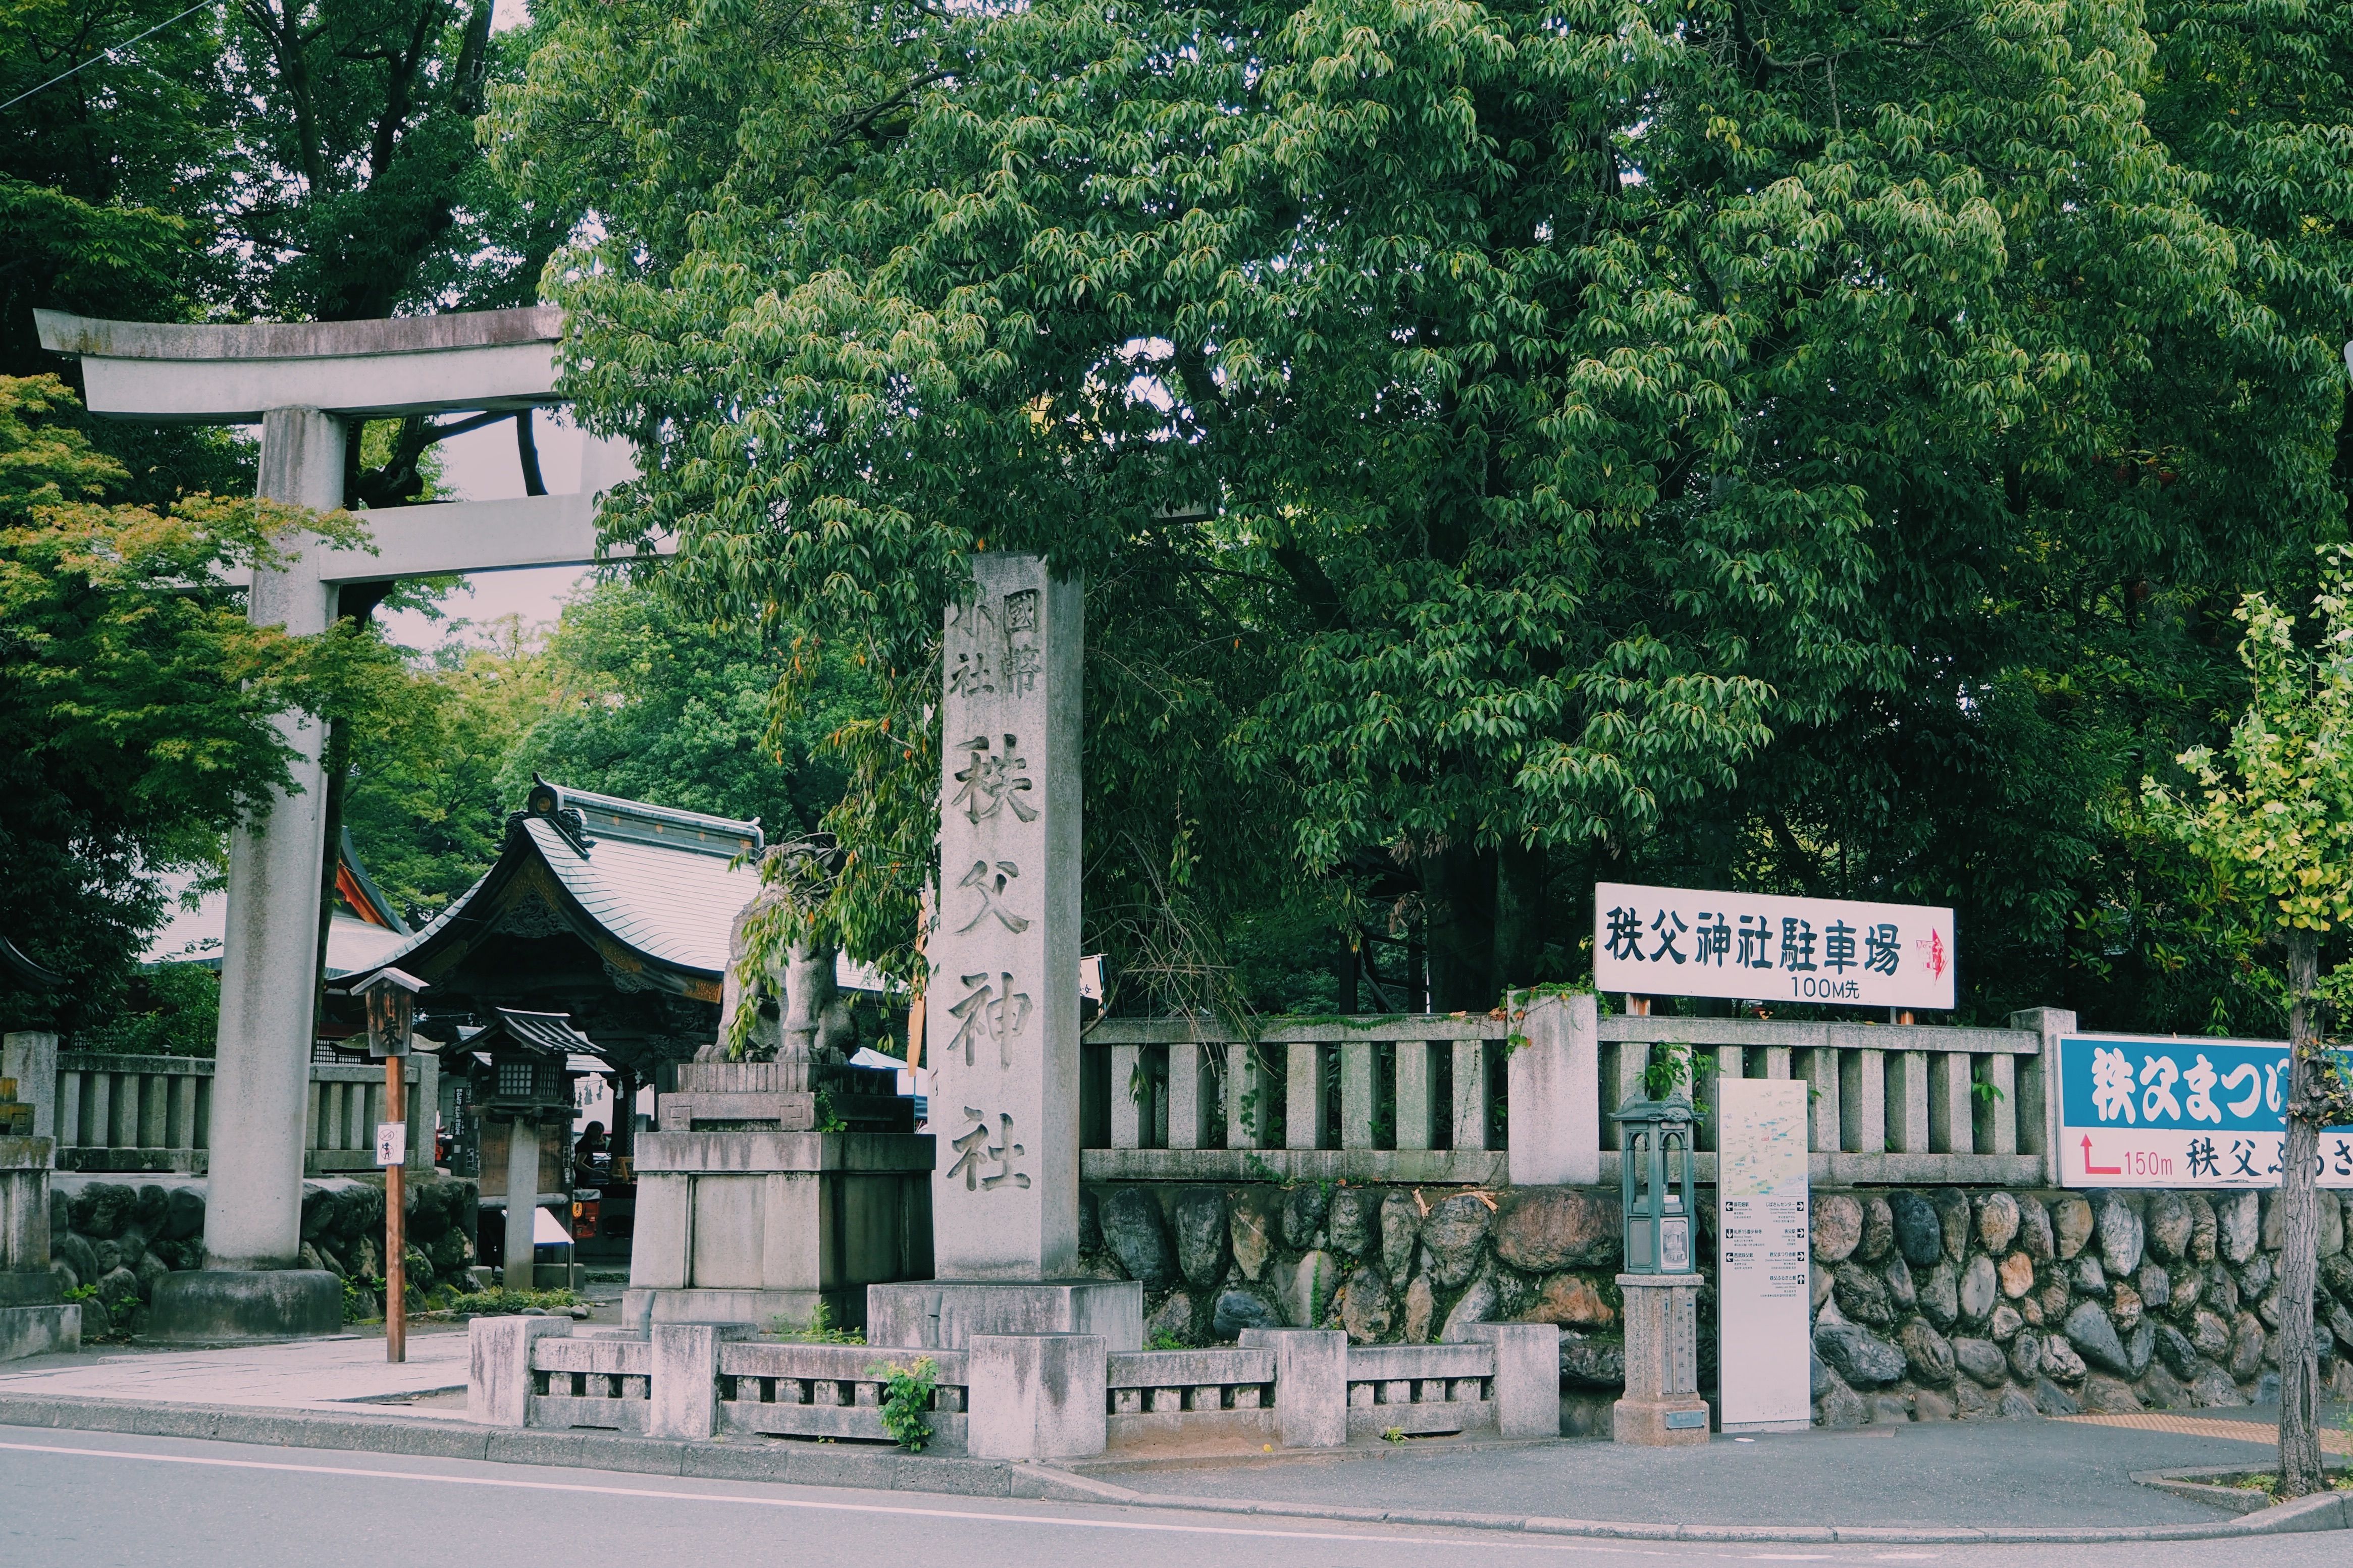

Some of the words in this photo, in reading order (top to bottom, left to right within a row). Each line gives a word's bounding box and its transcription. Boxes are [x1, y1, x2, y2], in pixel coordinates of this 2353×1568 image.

[948, 733, 1040, 1192] 秩父神社
[1604, 905, 1901, 977] 秩父神社駐車場
[1791, 976, 1860, 999] 100M先
[2124, 1151, 2173, 1176] 150m
